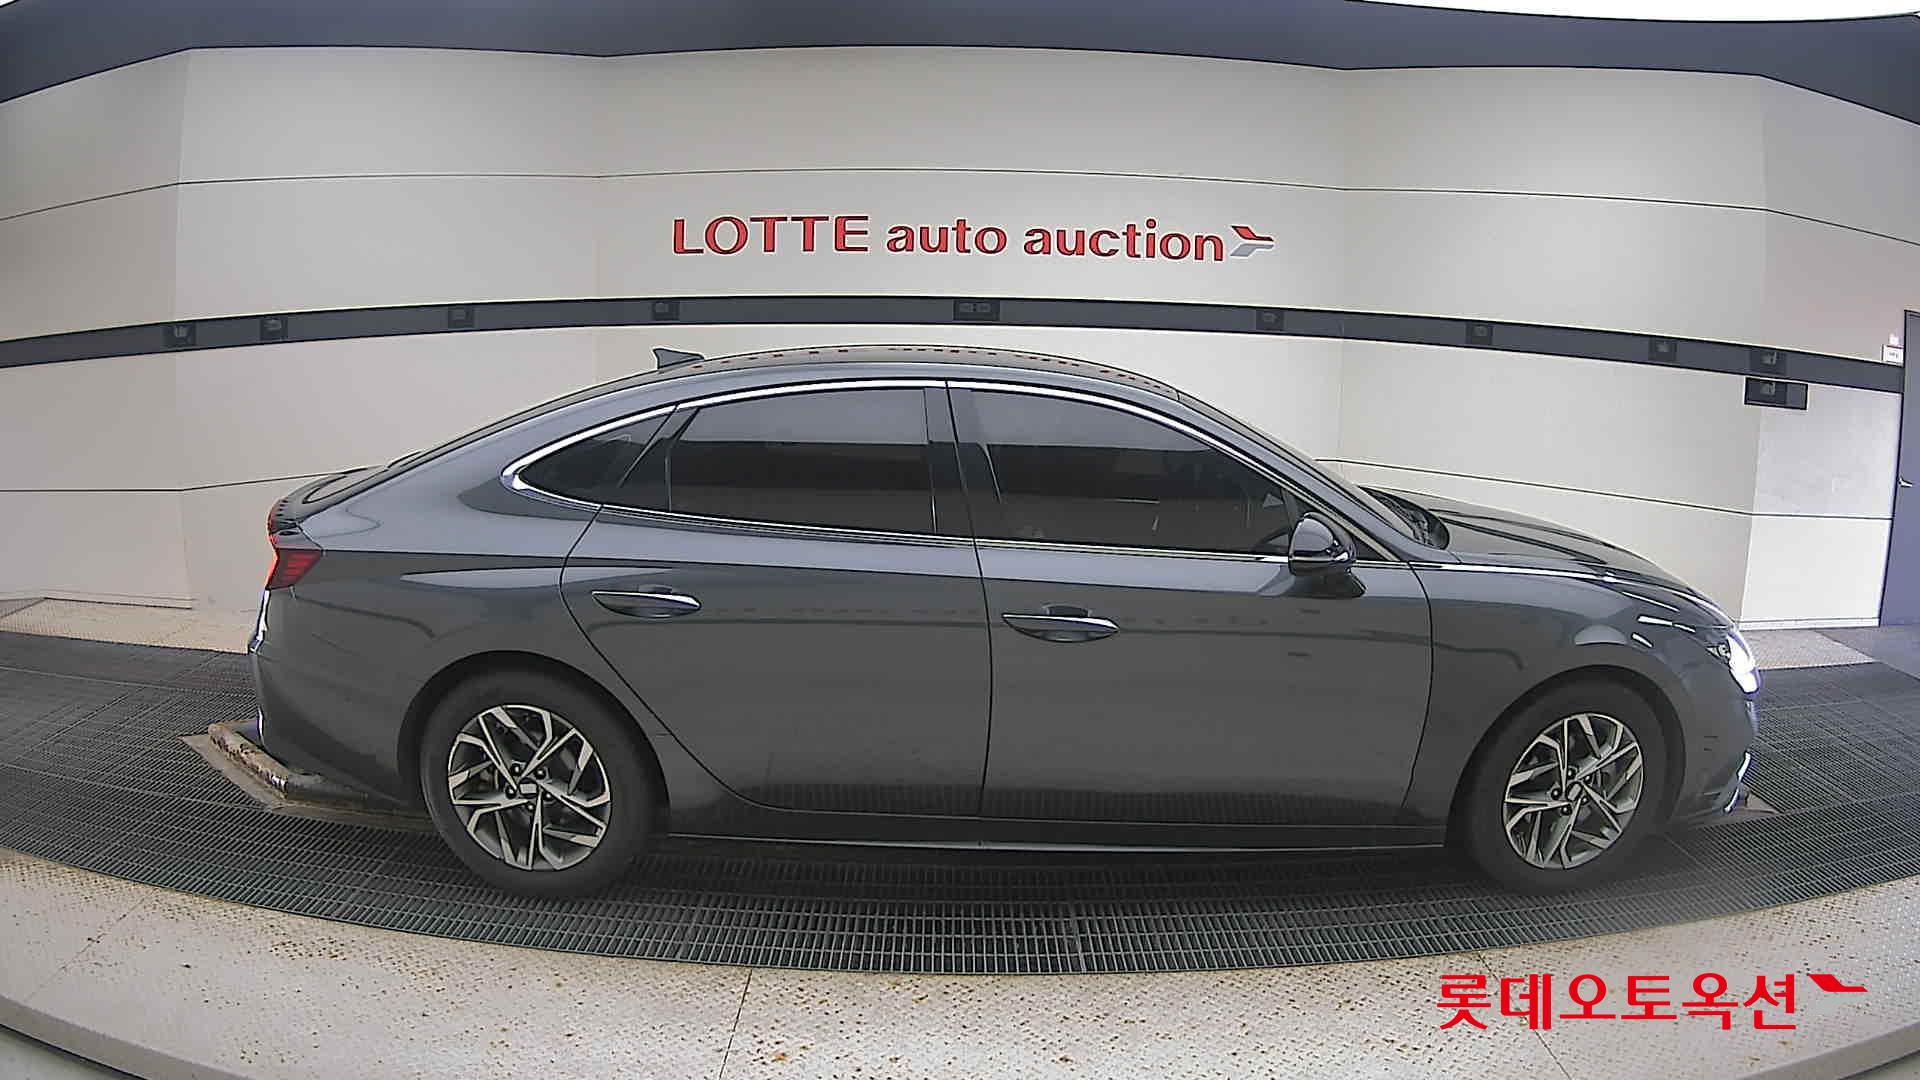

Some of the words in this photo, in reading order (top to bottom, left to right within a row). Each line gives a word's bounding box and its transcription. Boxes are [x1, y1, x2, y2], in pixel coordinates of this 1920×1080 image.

[673, 215, 870, 256] LOTTE
[886, 219, 1008, 255] auto
[1023, 218, 1225, 262] auction
